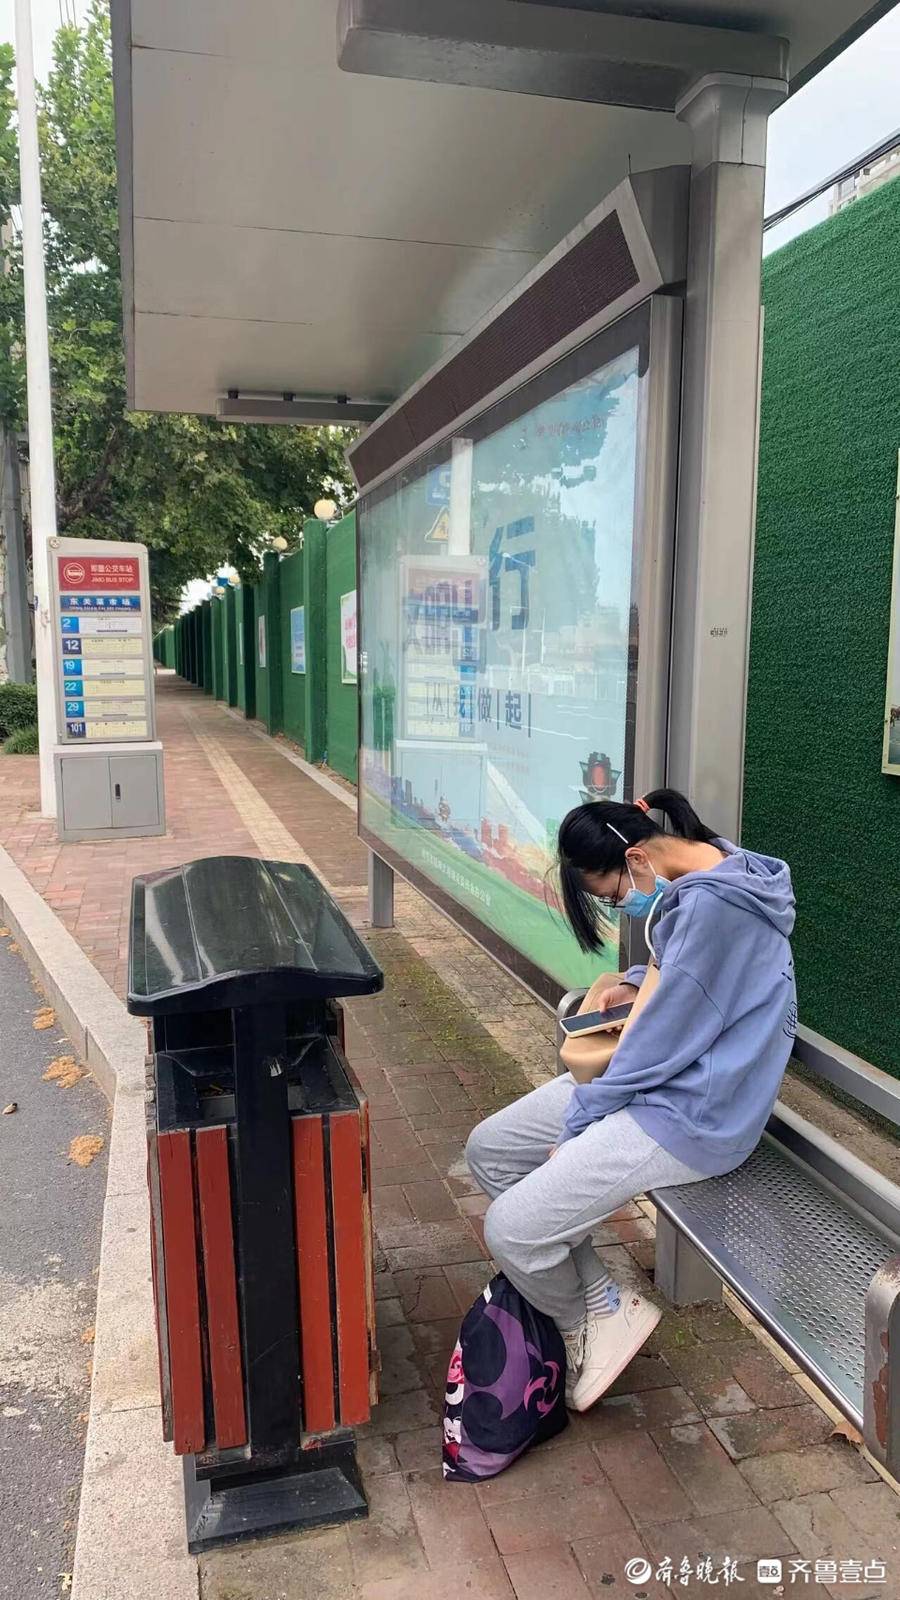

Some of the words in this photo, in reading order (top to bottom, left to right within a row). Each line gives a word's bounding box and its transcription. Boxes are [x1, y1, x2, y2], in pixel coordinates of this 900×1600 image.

[62, 618, 71, 628] 2
[65, 639, 80, 650] 12
[63, 660, 75, 670] 19
[65, 681, 77, 691] 22
[67, 702, 79, 712] 29
[70, 723, 83, 733] 101
